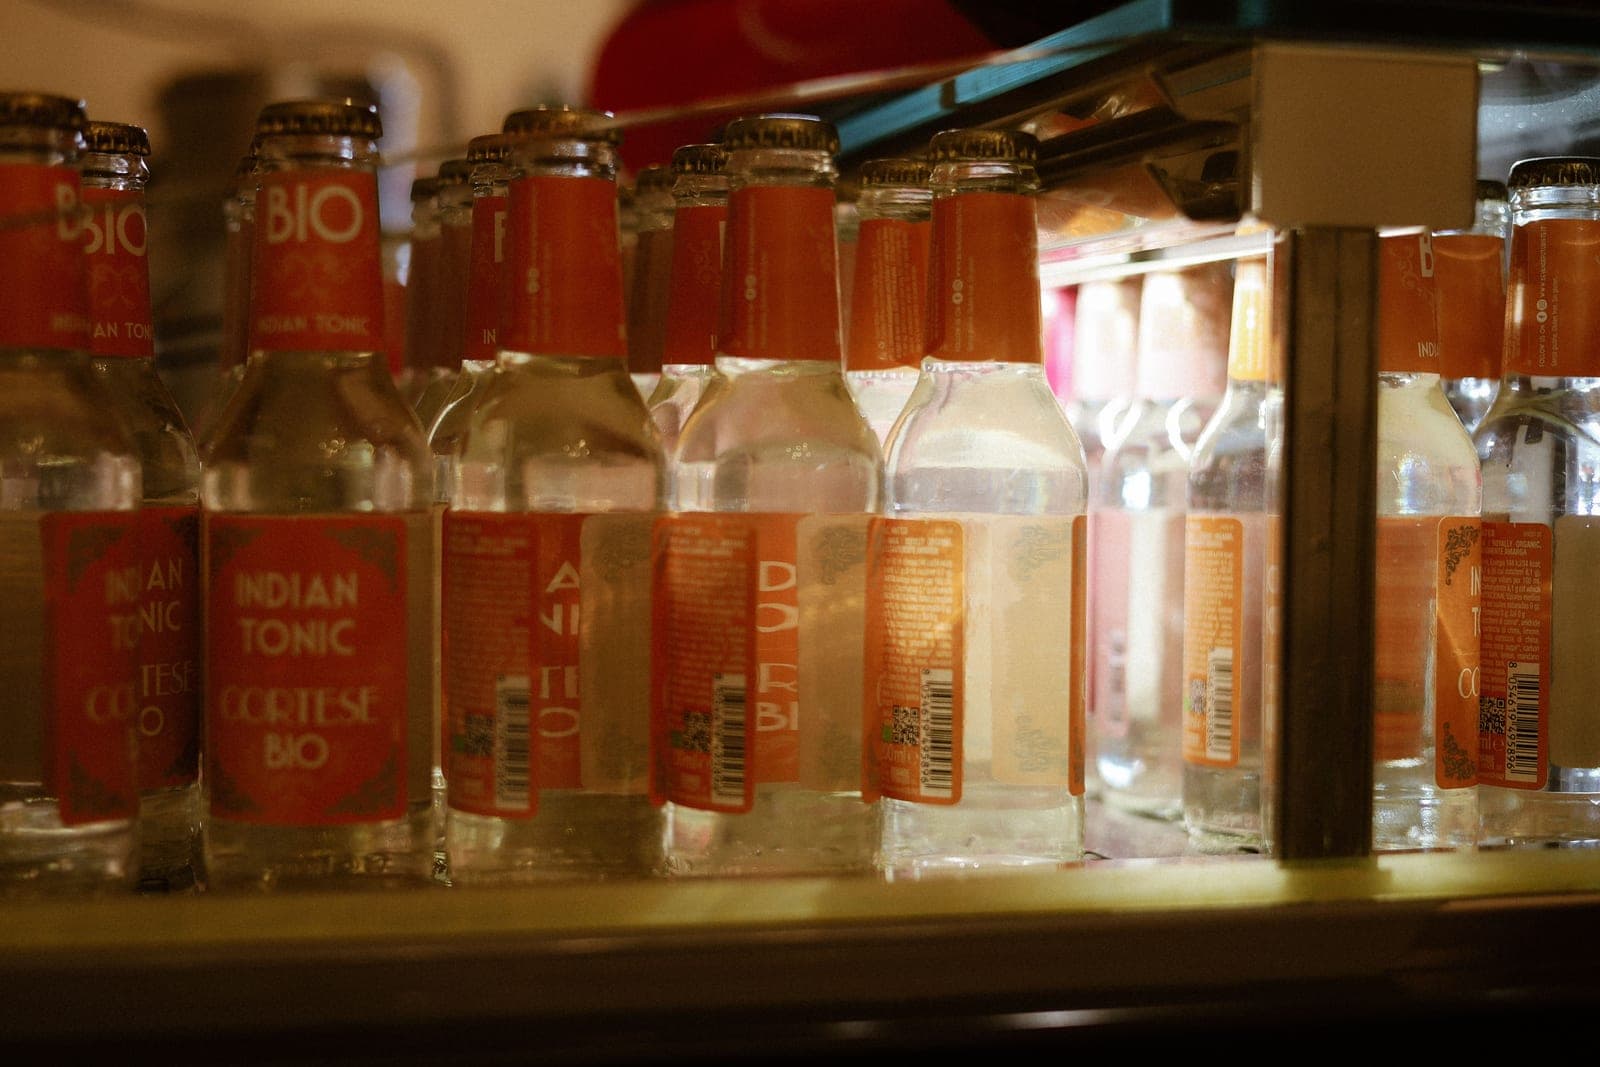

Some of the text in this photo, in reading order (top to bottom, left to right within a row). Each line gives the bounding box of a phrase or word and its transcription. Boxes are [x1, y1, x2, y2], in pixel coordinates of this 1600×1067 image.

[267, 184, 364, 243] BIO
[235, 571, 358, 609] INDIAN
[239, 617, 357, 657] TONIC
[222, 686, 378, 726] CORTESE
[1508, 677, 1518, 721] 054619
[264, 733, 330, 770] BIO
[1506, 726, 1516, 769] 495896
